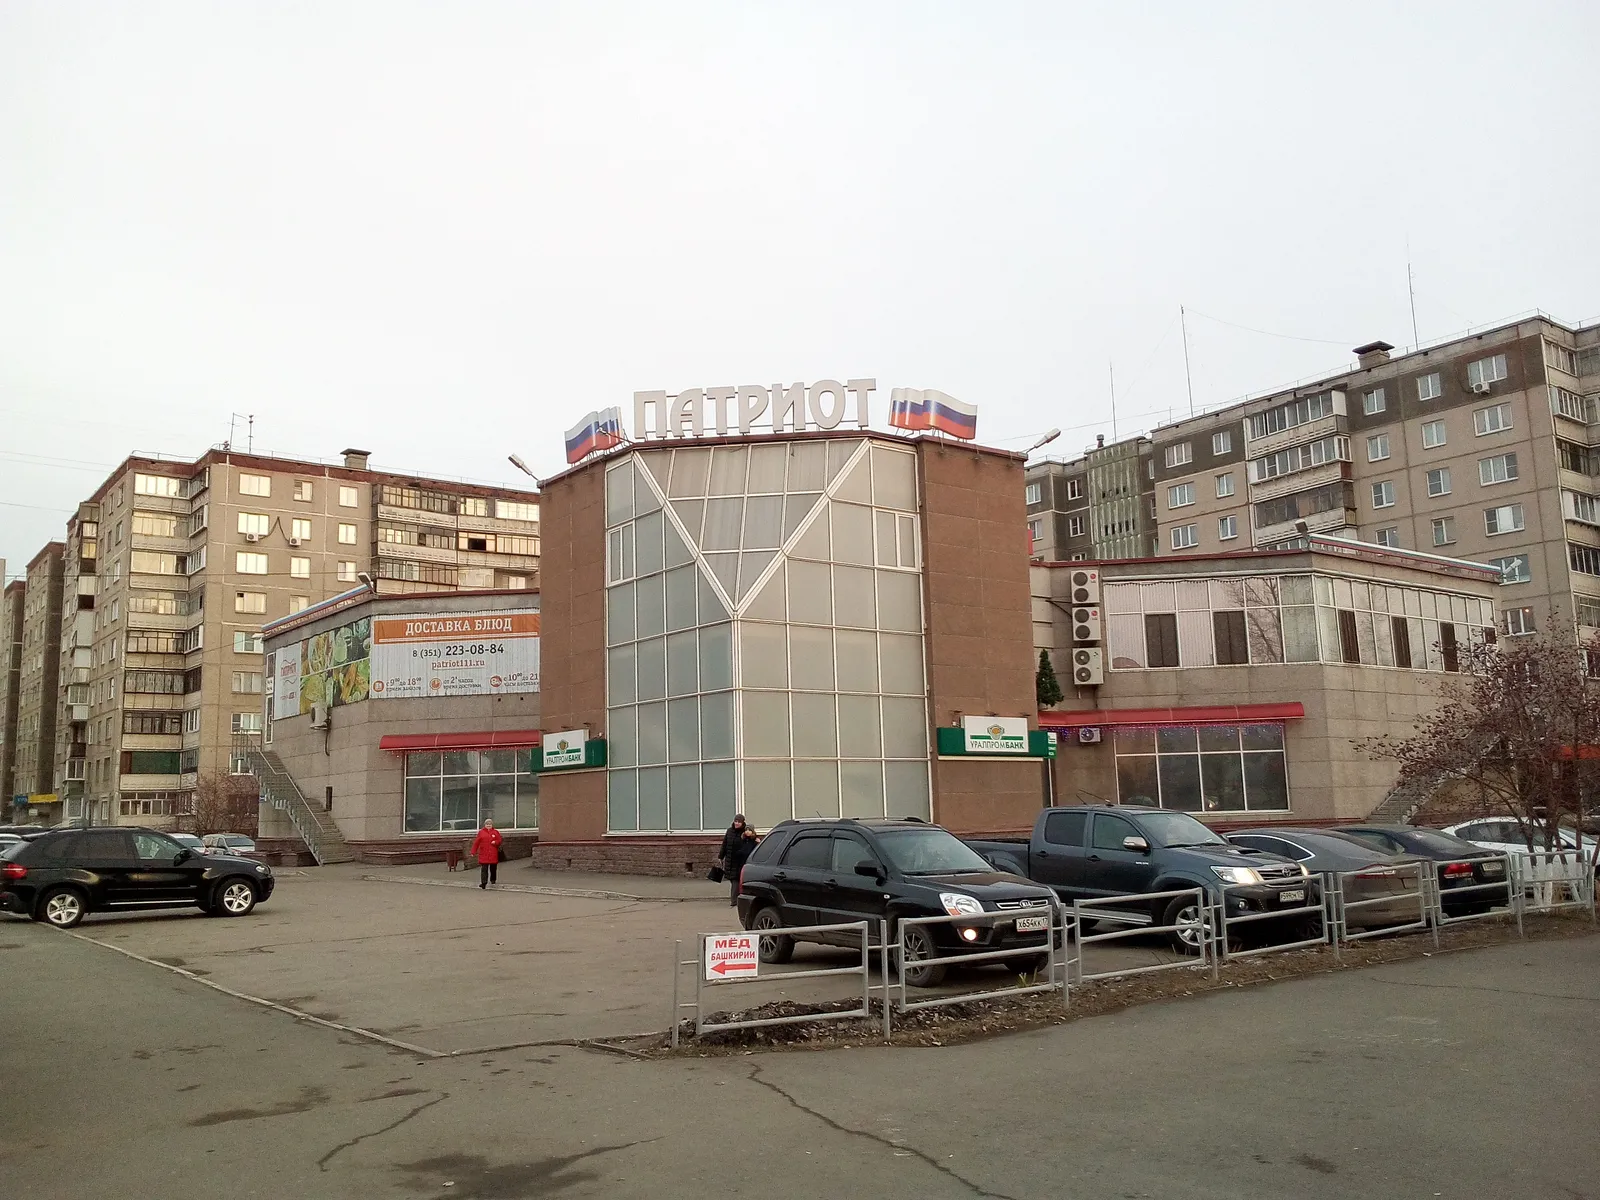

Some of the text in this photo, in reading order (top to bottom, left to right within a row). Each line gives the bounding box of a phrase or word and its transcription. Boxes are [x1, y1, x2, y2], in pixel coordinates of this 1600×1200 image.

[633, 377, 876, 439] ПАТРИОТ
[405, 617, 513, 636] ДОСТАВКА БЛЮД
[412, 643, 505, 659] 8 (351) 223-08-84
[432, 659, 485, 670] patriot111.ru
[970, 740, 1025, 750] УРАЛПРОМБАНК
[715, 937, 751, 949] МЁД
[711, 950, 756, 961] БАШКИРИИ
